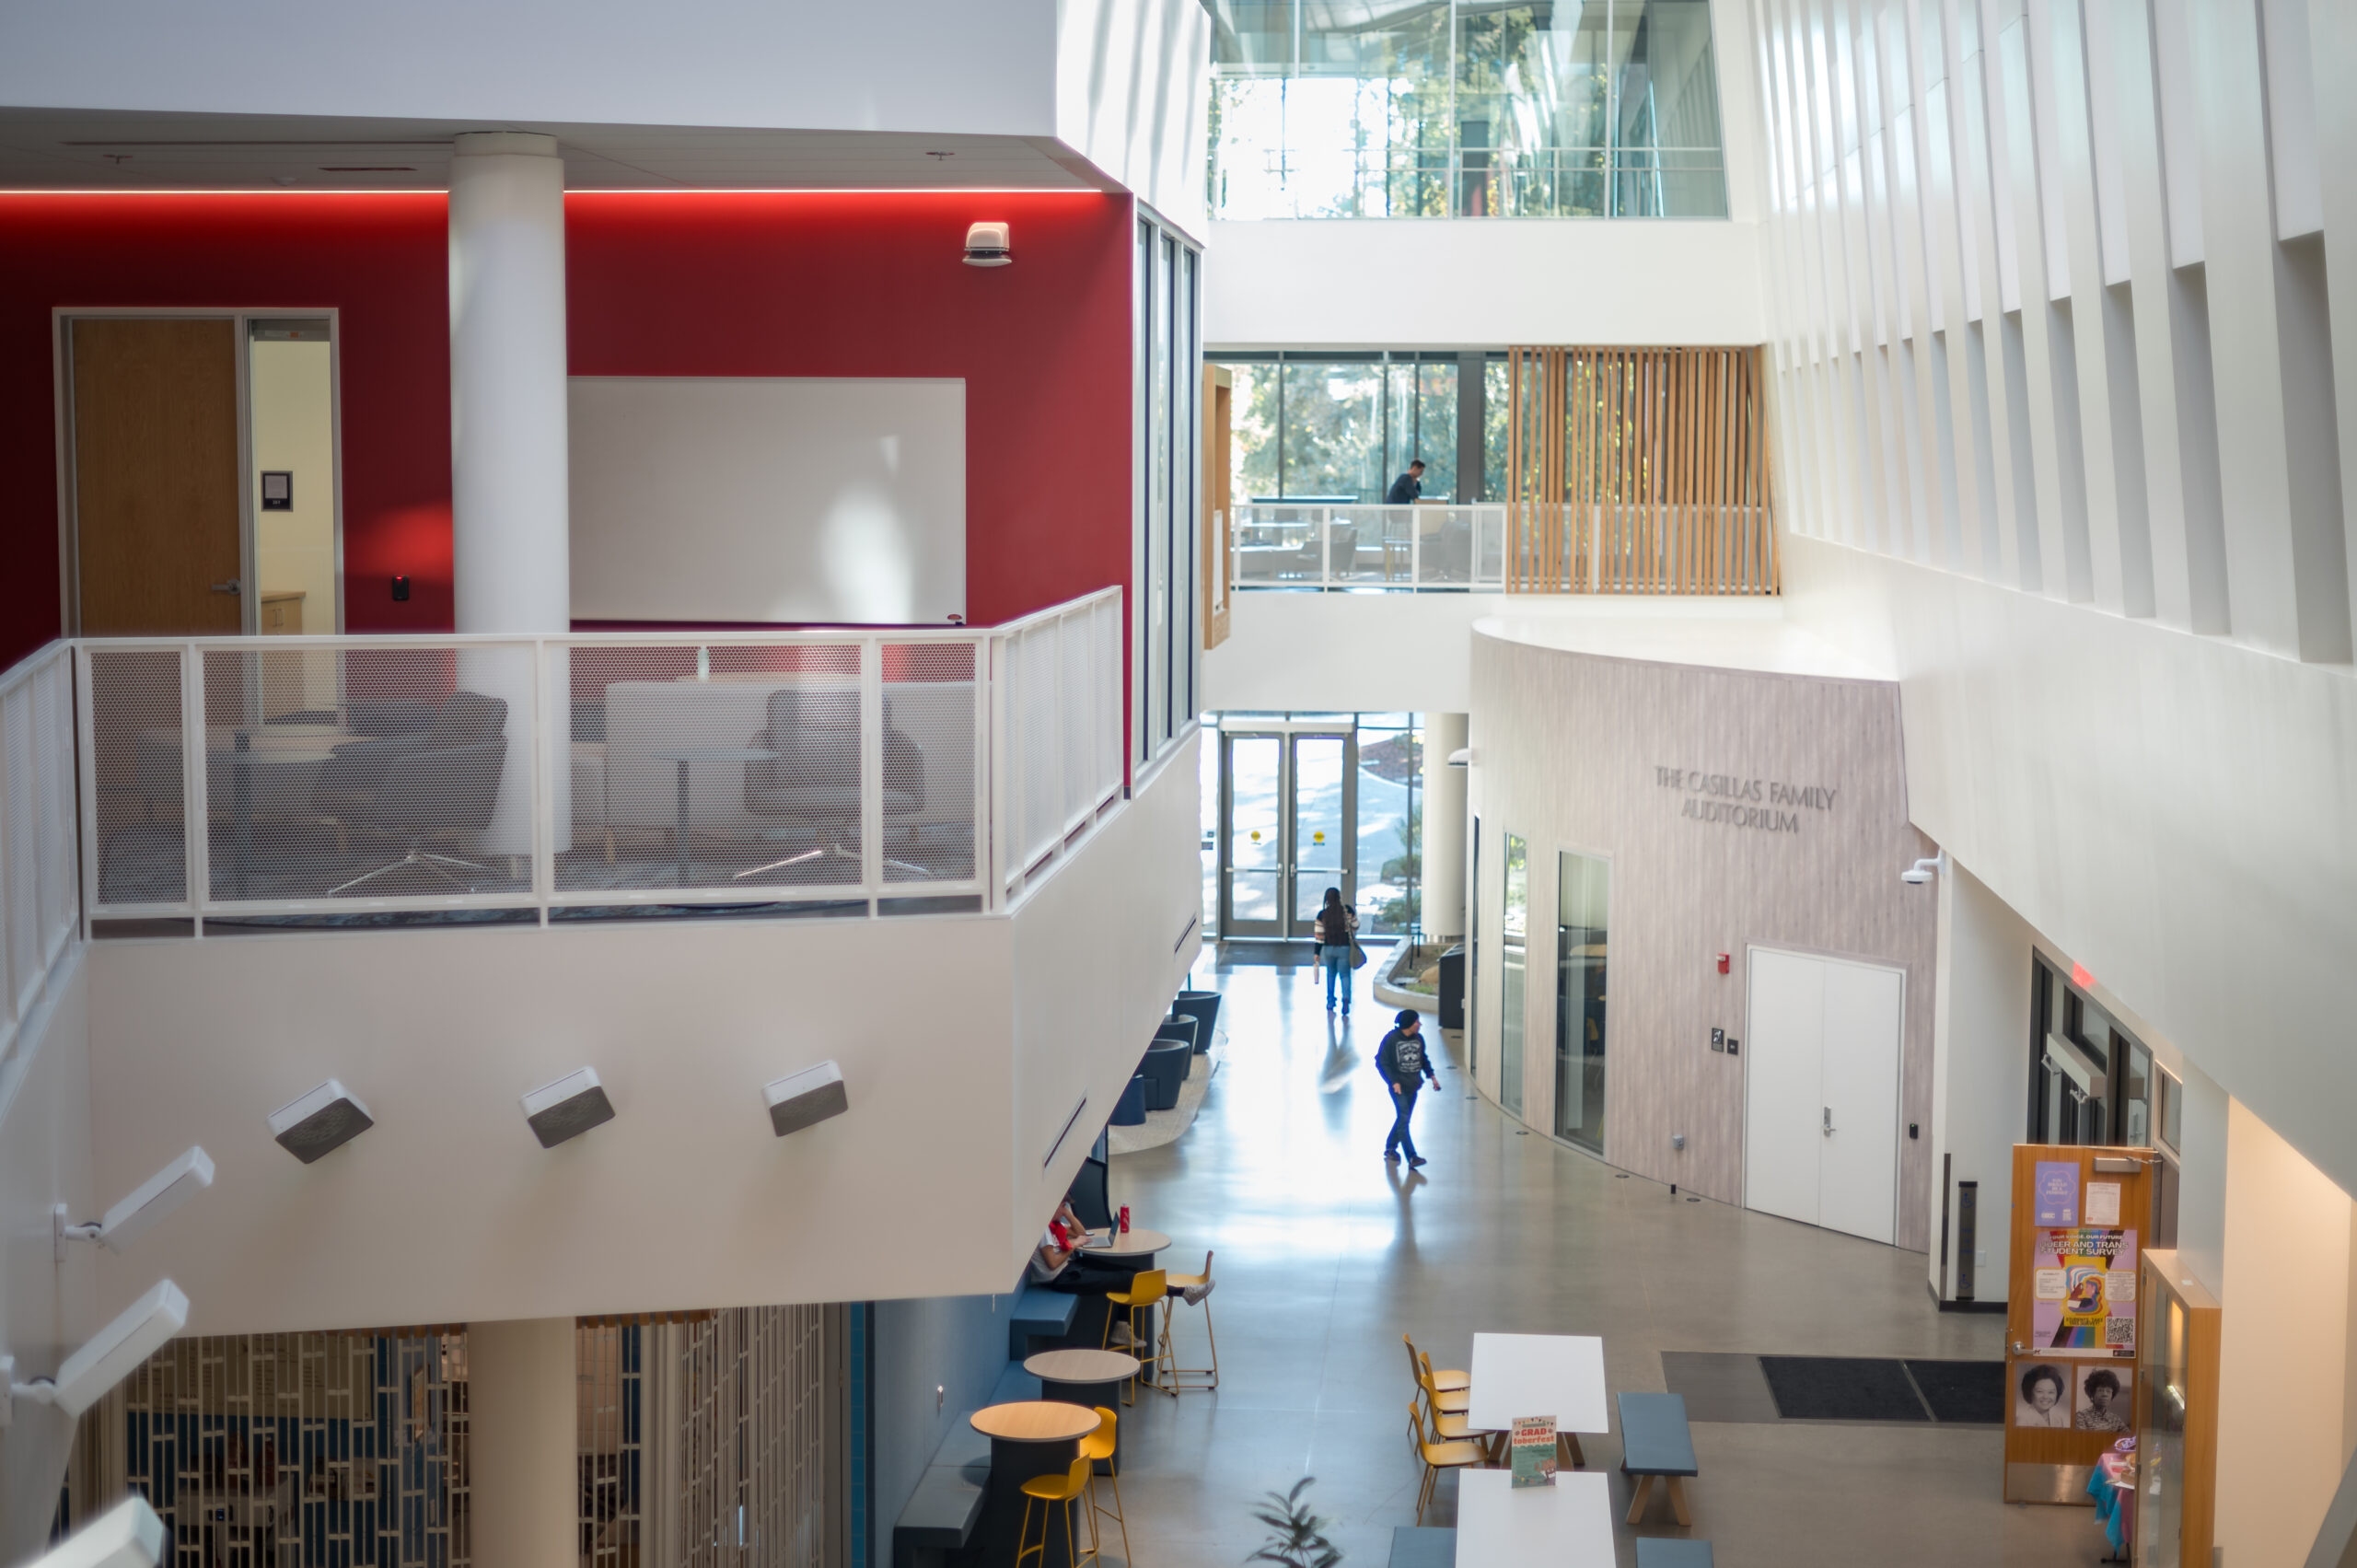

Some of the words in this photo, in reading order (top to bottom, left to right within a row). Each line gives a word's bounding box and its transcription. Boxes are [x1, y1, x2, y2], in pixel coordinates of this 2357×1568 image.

[1655, 765, 1684, 789] THE
[1689, 771, 1762, 803] CASILLAS
[1770, 782, 1837, 811] FAMILY
[1681, 798, 1800, 833] AUDITORIUM
[1514, 1435, 1555, 1445] toberfest
[1521, 1428, 1547, 1436] GRAD
